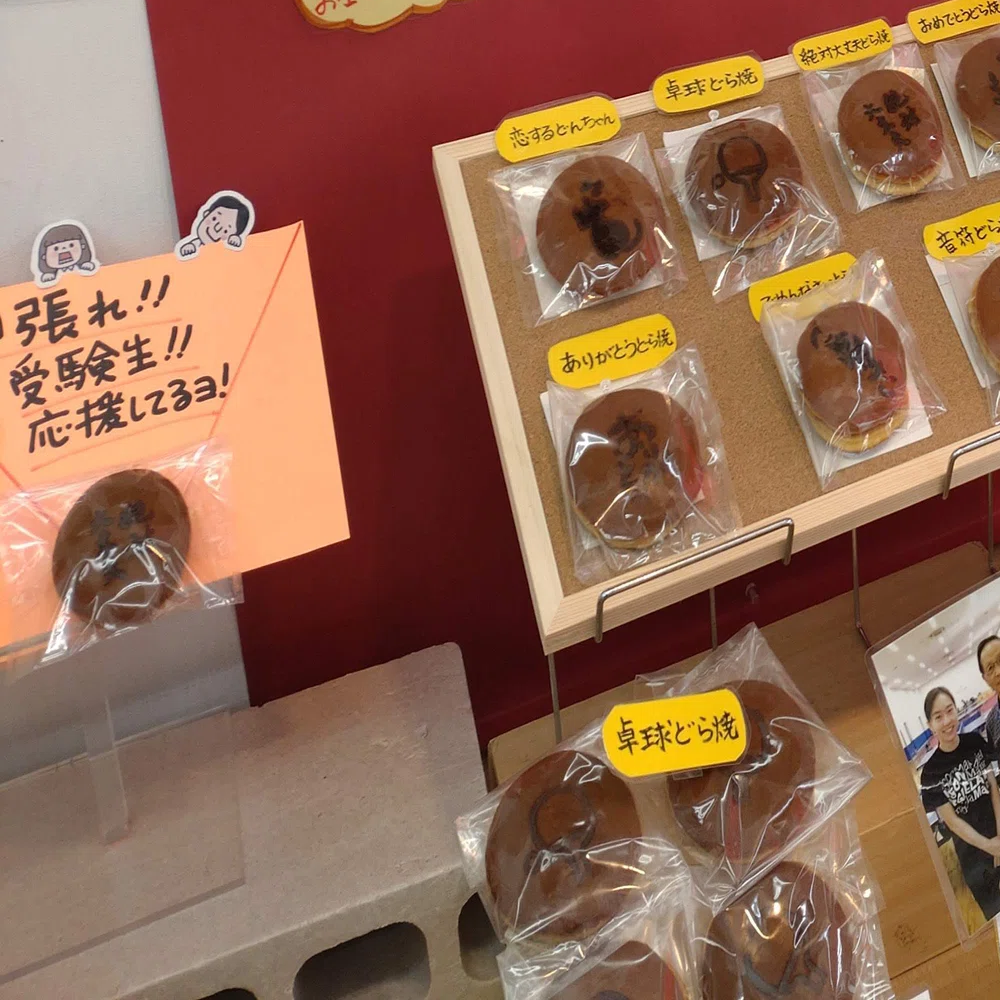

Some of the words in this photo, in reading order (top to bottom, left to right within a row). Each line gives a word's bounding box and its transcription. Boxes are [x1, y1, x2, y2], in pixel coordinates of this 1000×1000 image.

[664, 67, 759, 101] 卓球どら焼
[0, 274, 172, 346] 張れ!!
[617, 710, 740, 757] 卓球どら焼
